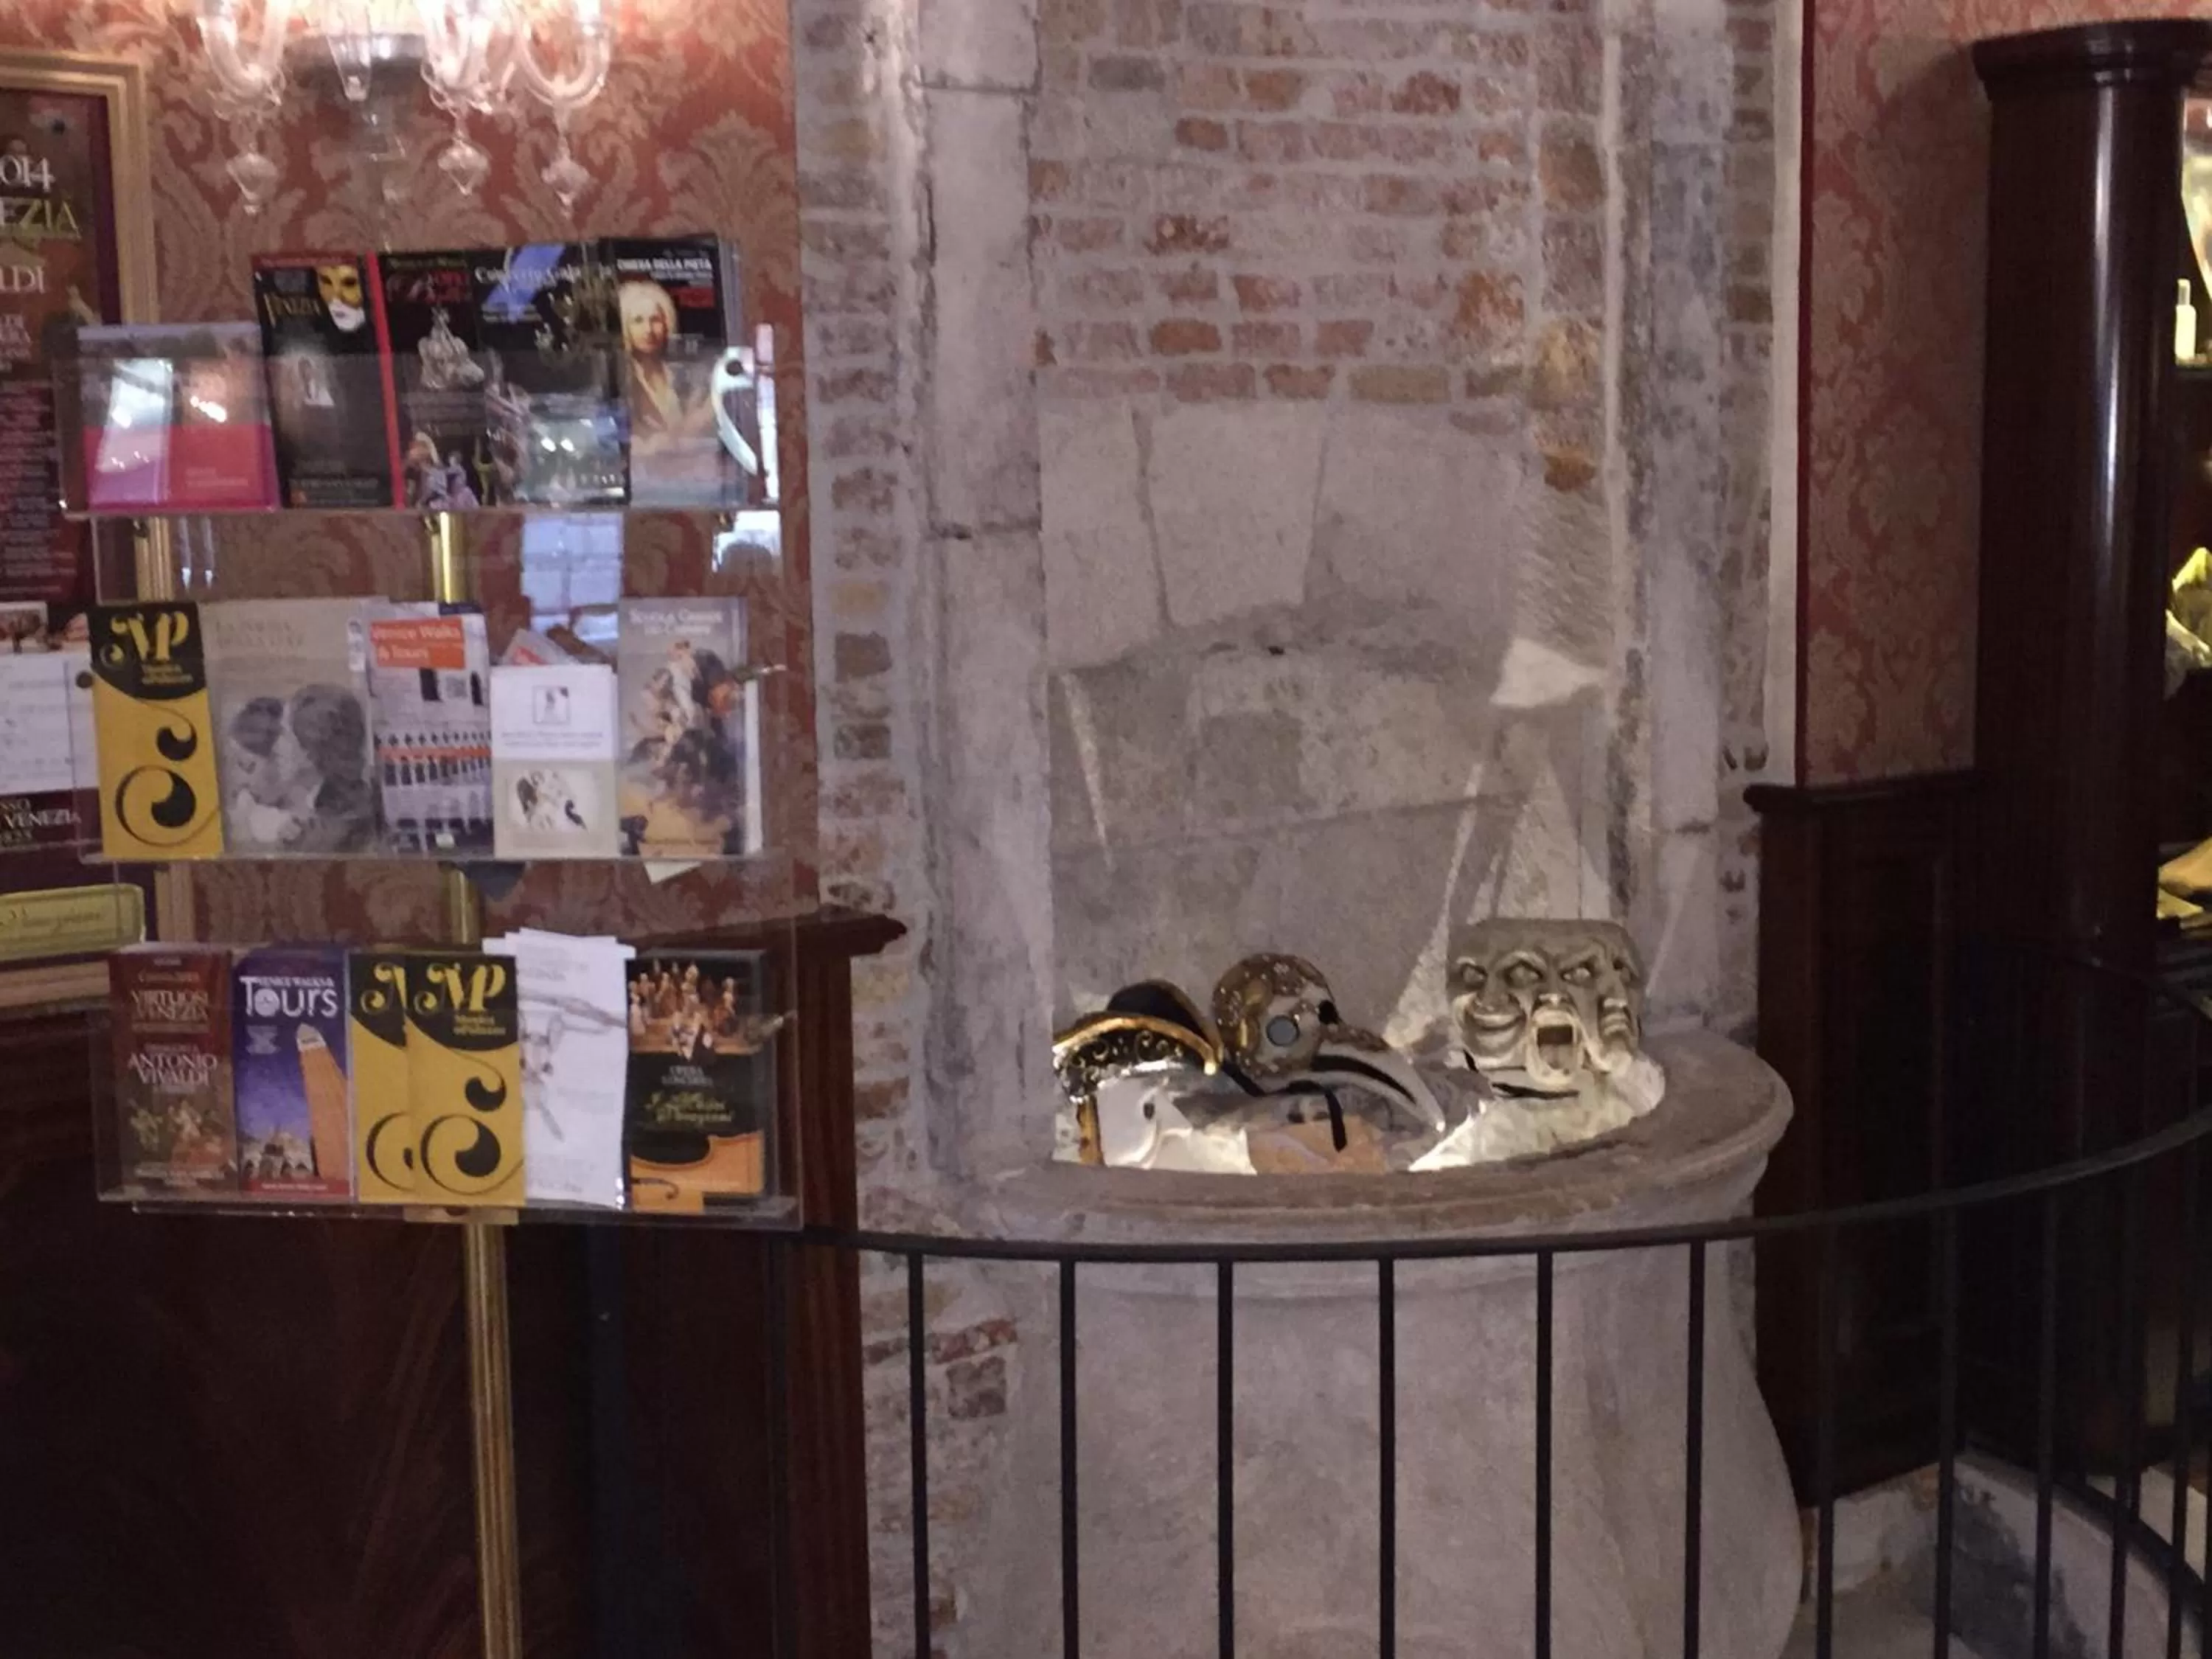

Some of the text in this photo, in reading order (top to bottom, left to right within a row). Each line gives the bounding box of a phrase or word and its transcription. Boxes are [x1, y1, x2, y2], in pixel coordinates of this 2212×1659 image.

[239, 975, 338, 1018] Tours
[127, 1053, 218, 1071] ANTONIO
[136, 1067, 210, 1087] VIVALDI
